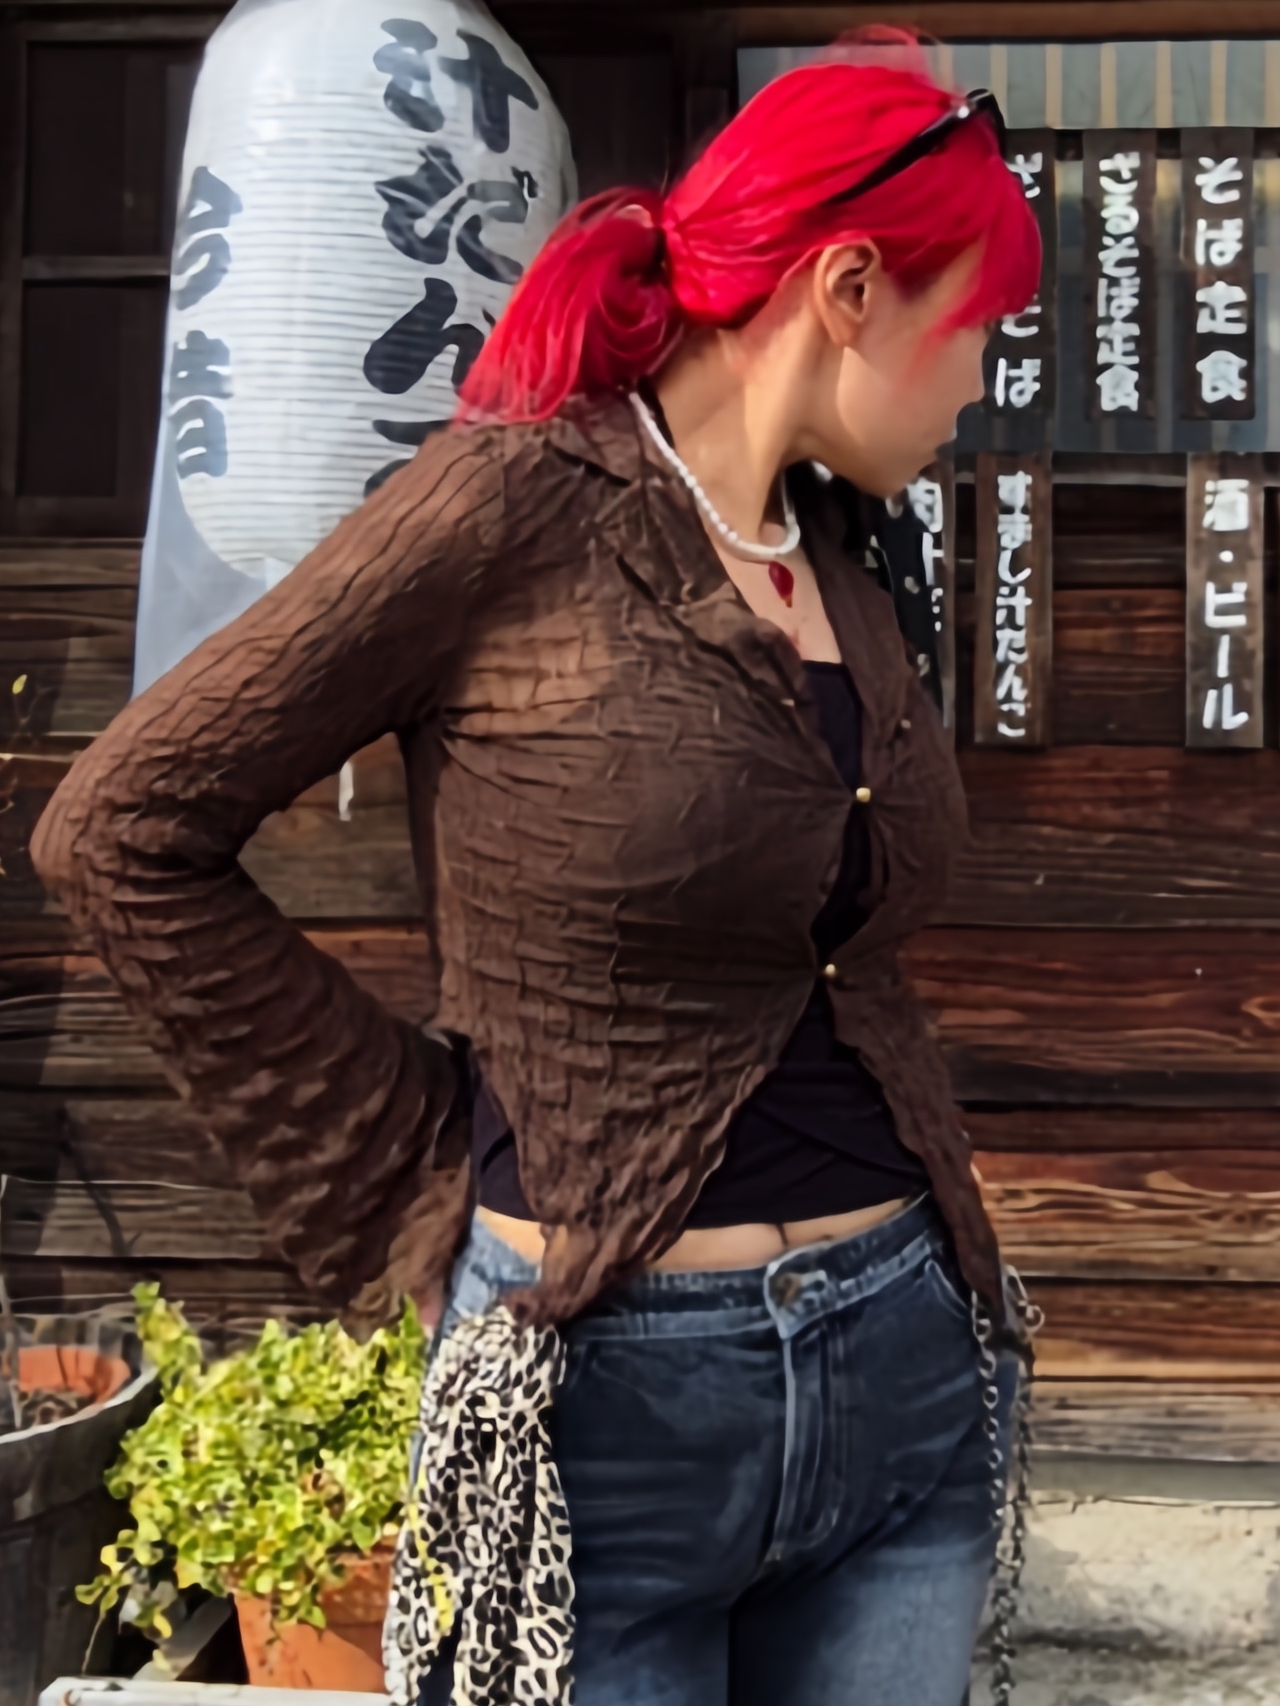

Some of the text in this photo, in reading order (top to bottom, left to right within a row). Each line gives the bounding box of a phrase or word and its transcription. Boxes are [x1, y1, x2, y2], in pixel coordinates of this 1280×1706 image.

[1195, 156, 1248, 404] そば定食
[1202, 478, 1249, 731] 酒・ビール
